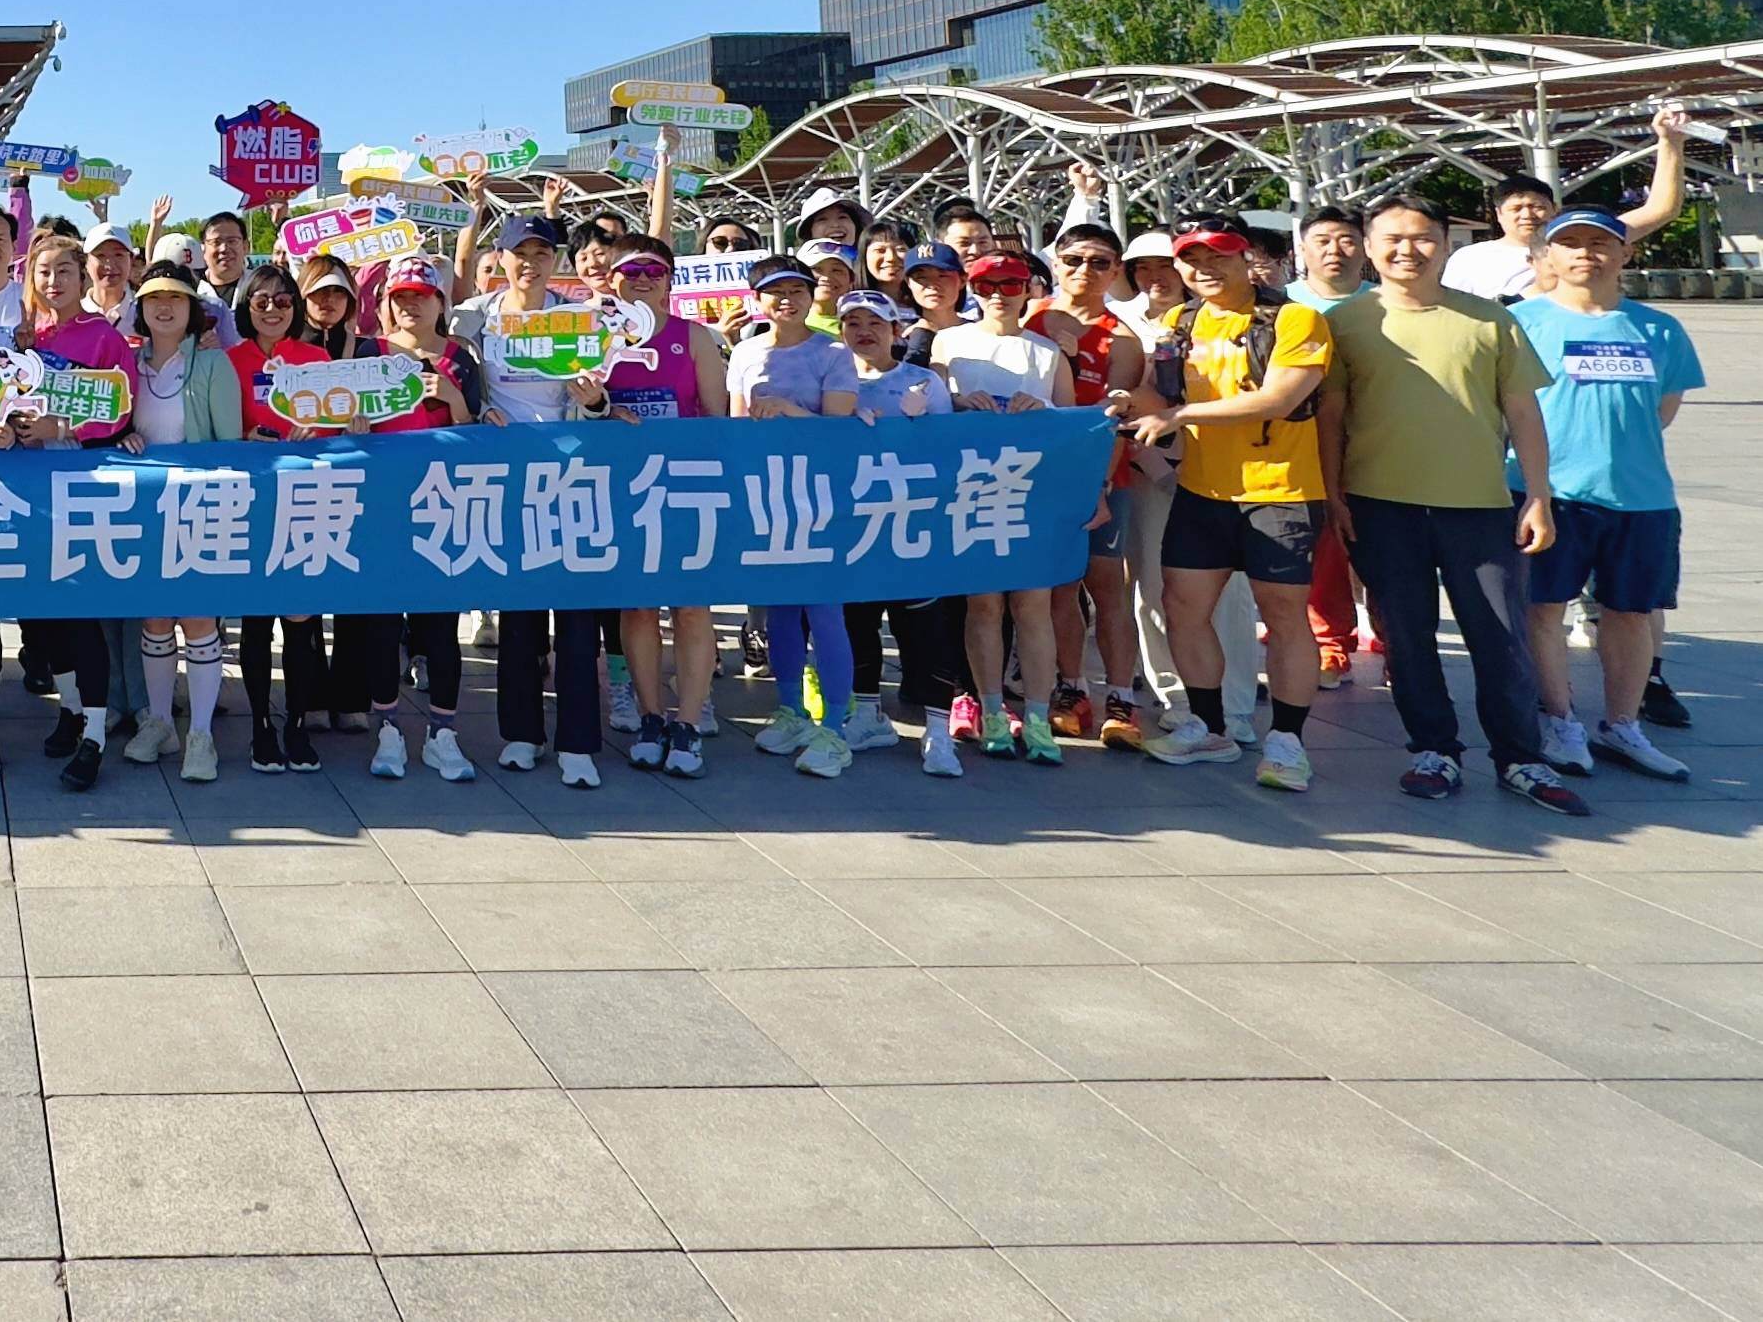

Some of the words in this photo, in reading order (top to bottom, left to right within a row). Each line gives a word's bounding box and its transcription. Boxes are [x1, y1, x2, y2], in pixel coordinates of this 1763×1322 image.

[234, 127, 301, 160] 燃脂
[255, 165, 316, 184] CLUB
[407, 202, 469, 223] 行业先锋
[295, 215, 341, 244] 你是
[1578, 360, 1644, 372] A6668
[622, 404, 668, 416] 8957
[409, 446, 1044, 576] 领跑行业先锋
